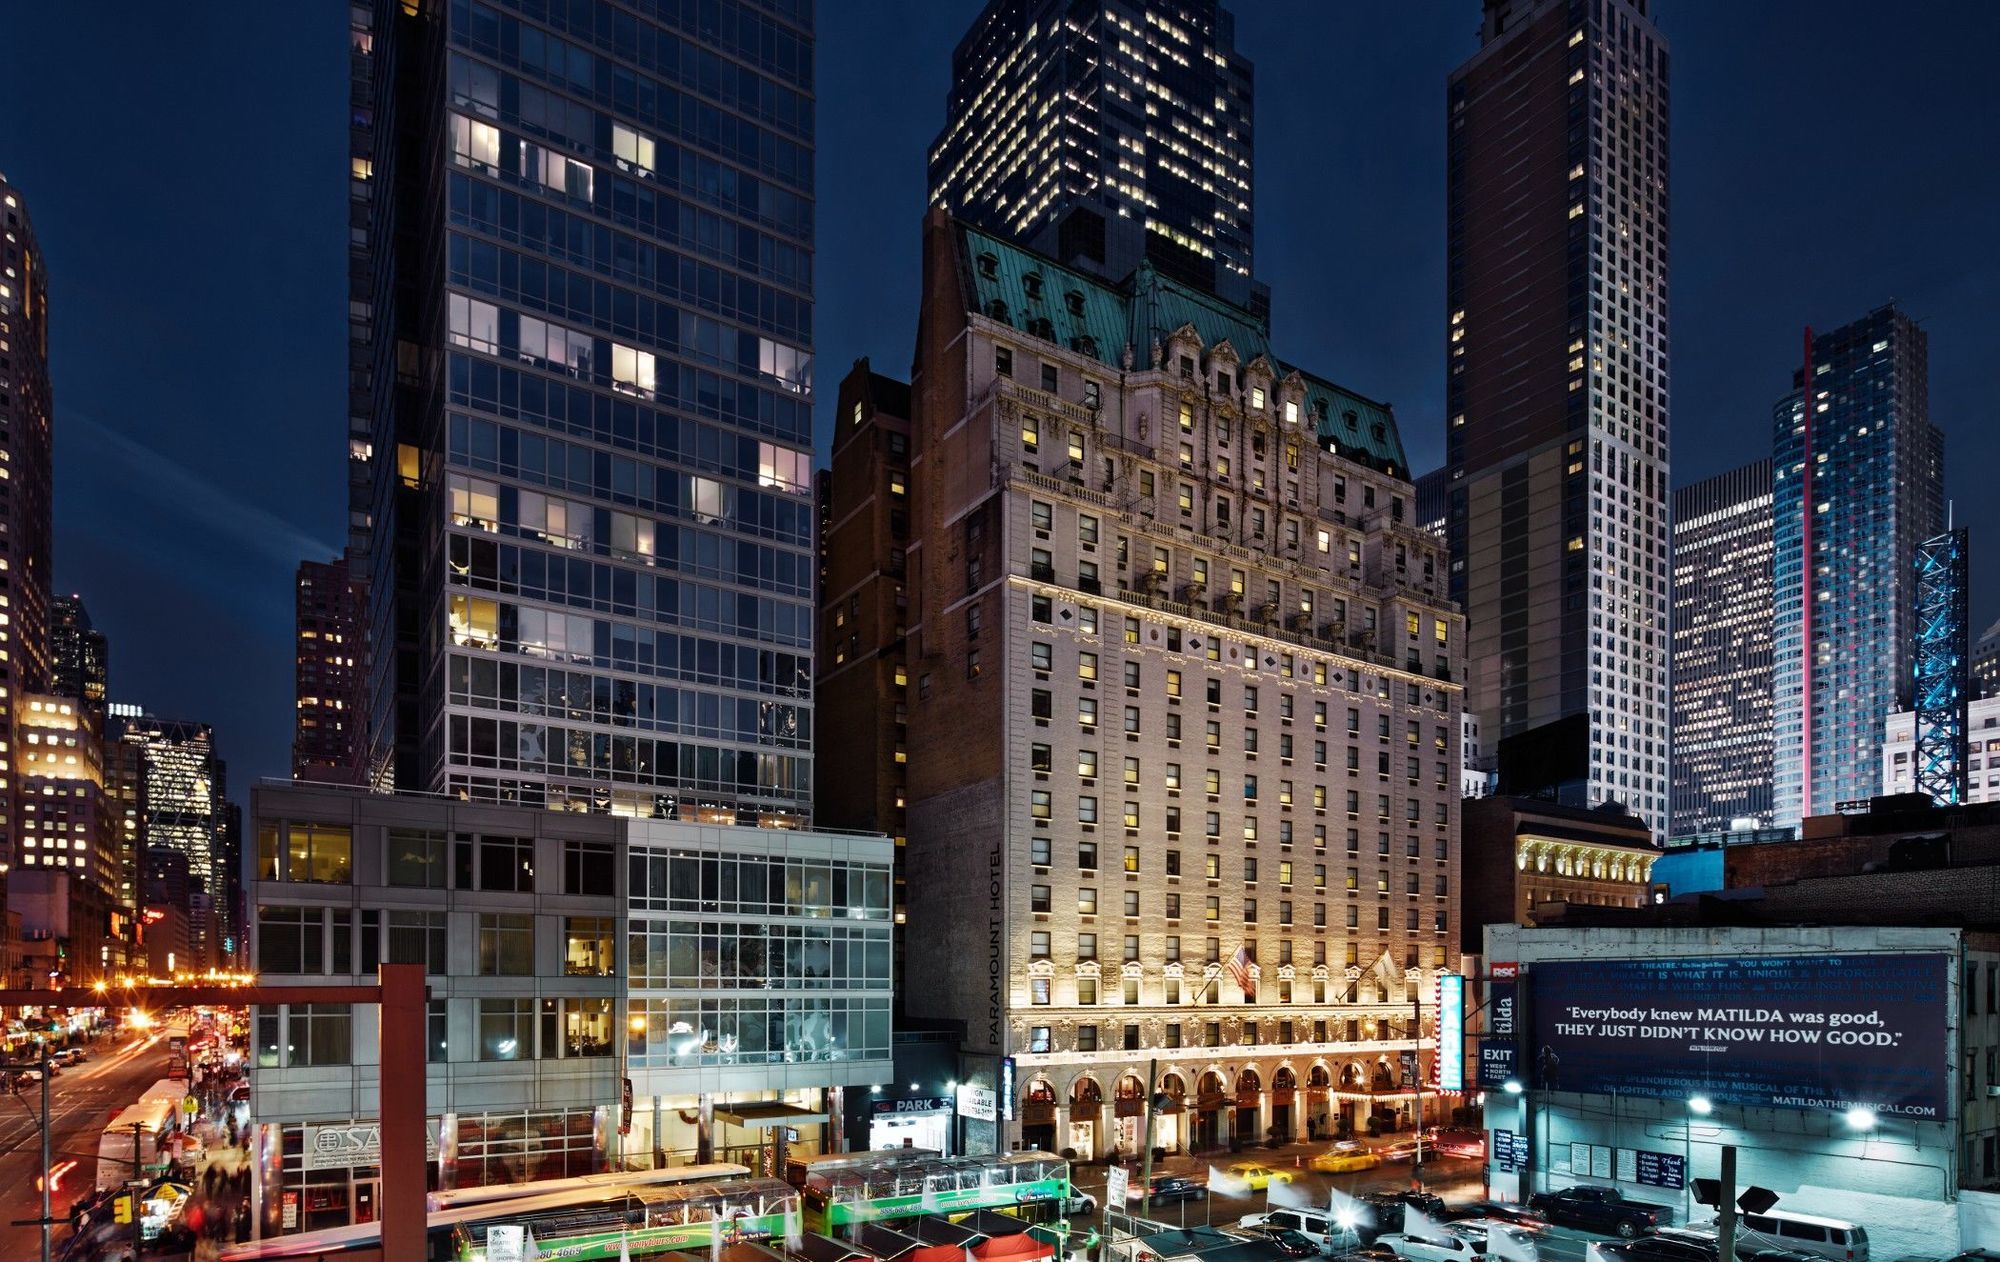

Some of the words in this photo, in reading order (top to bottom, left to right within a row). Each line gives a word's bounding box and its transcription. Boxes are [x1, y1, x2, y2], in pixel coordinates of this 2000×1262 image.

[989, 842, 1000, 911] HOTEL
[1492, 967, 1515, 978] RSC
[1658, 971, 1668, 979] IS
[1672, 971, 1708, 979] WHAT
[1712, 970, 1722, 978] IT
[989, 917, 1000, 1045] PARAMOUNT
[1493, 997, 1512, 1034] tilda
[1566, 1006, 1648, 1022] "Everybody
[1650, 1007, 1693, 1021] knew
[1697, 1008, 1785, 1023] MATILDA
[1788, 1012, 1825, 1024] was
[1829, 1010, 1885, 1028] good,
[1554, 1023, 1595, 1036] THEY
[1598, 1024, 1637, 1038] JUST
[1640, 1025, 1700, 1040] DIDN'T
[1703, 1027, 1766, 1041] KNOW
[1769, 1029, 1822, 1044] HOW
[1826, 1030, 1903, 1047] GOOD."
[1483, 1049, 1512, 1061] EXIT
[1661, 1088, 1683, 1098] AND
[1704, 1080, 1728, 1089] NEW
[1731, 1081, 1780, 1093] MUSICAL
[1785, 1085, 1800, 1094] OF
[1803, 1086, 1825, 1096] THE
[896, 1098, 933, 1112] PARK
[1772, 1095, 1936, 1117] MATILDATHEMUSICAL.COM
[535, 1246, 581, 1260] 80-4669
